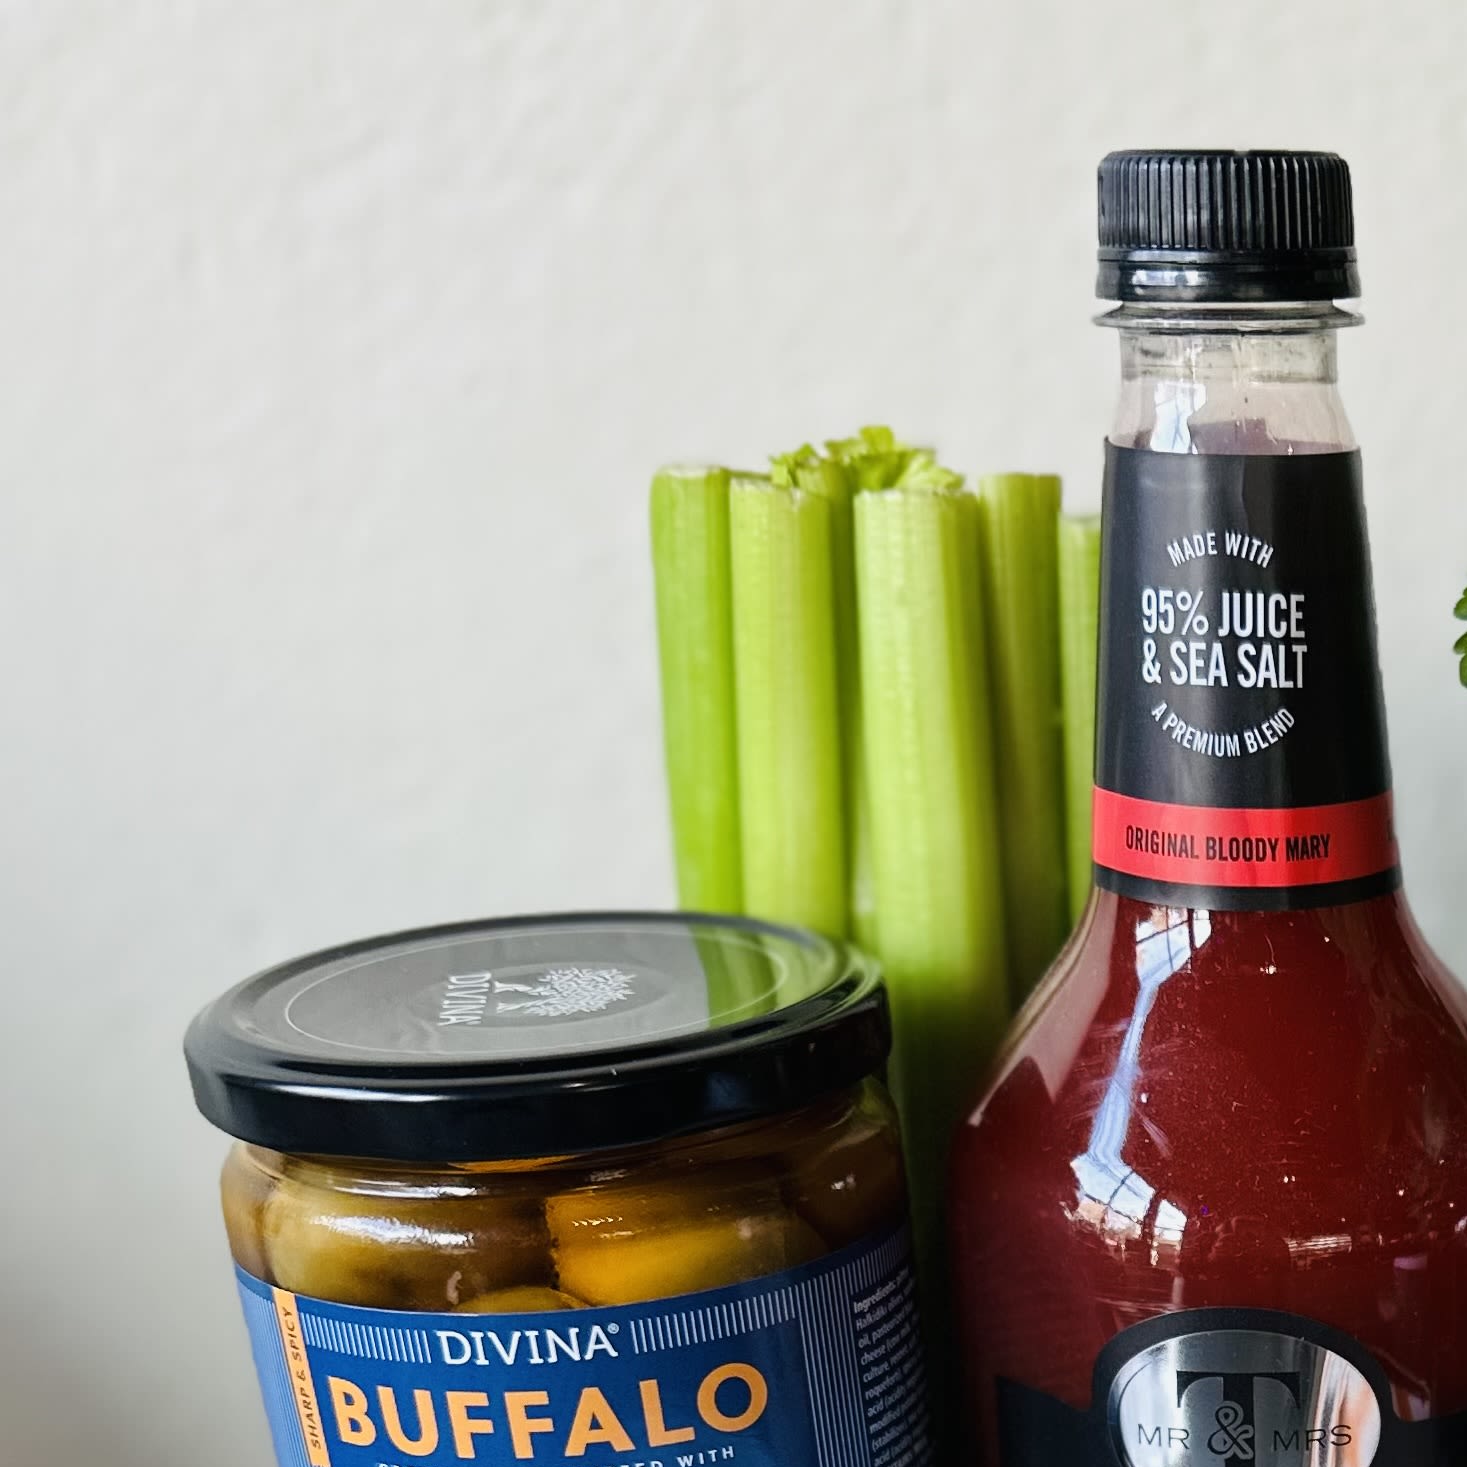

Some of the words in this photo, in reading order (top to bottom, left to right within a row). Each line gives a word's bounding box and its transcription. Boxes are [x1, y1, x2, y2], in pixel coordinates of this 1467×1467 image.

[1167, 532, 1218, 567] MADE
[1225, 532, 1274, 568] WITH
[1141, 588, 1209, 636] 95%
[1218, 592, 1306, 638] JUICE
[1142, 639, 1161, 684] &
[1170, 643, 1228, 687] SEA
[1237, 644, 1307, 688] SALT
[1152, 702, 1165, 722] A
[1163, 717, 1241, 757] PREMIUM
[1247, 708, 1295, 754] BLEND
[1125, 824, 1200, 860] ORIGINAL
[1205, 837, 1279, 863] BLOODY
[1285, 834, 1330, 860] MARY
[283, 1307, 302, 1362] SPICY
[295, 1369, 307, 1382] &
[300, 1387, 320, 1450] SHARP
[328, 1362, 769, 1460] BUFFALO
[1137, 1423, 1189, 1451] MR
[1207, 1400, 1255, 1460] &
[1273, 1424, 1353, 1452] MRS
